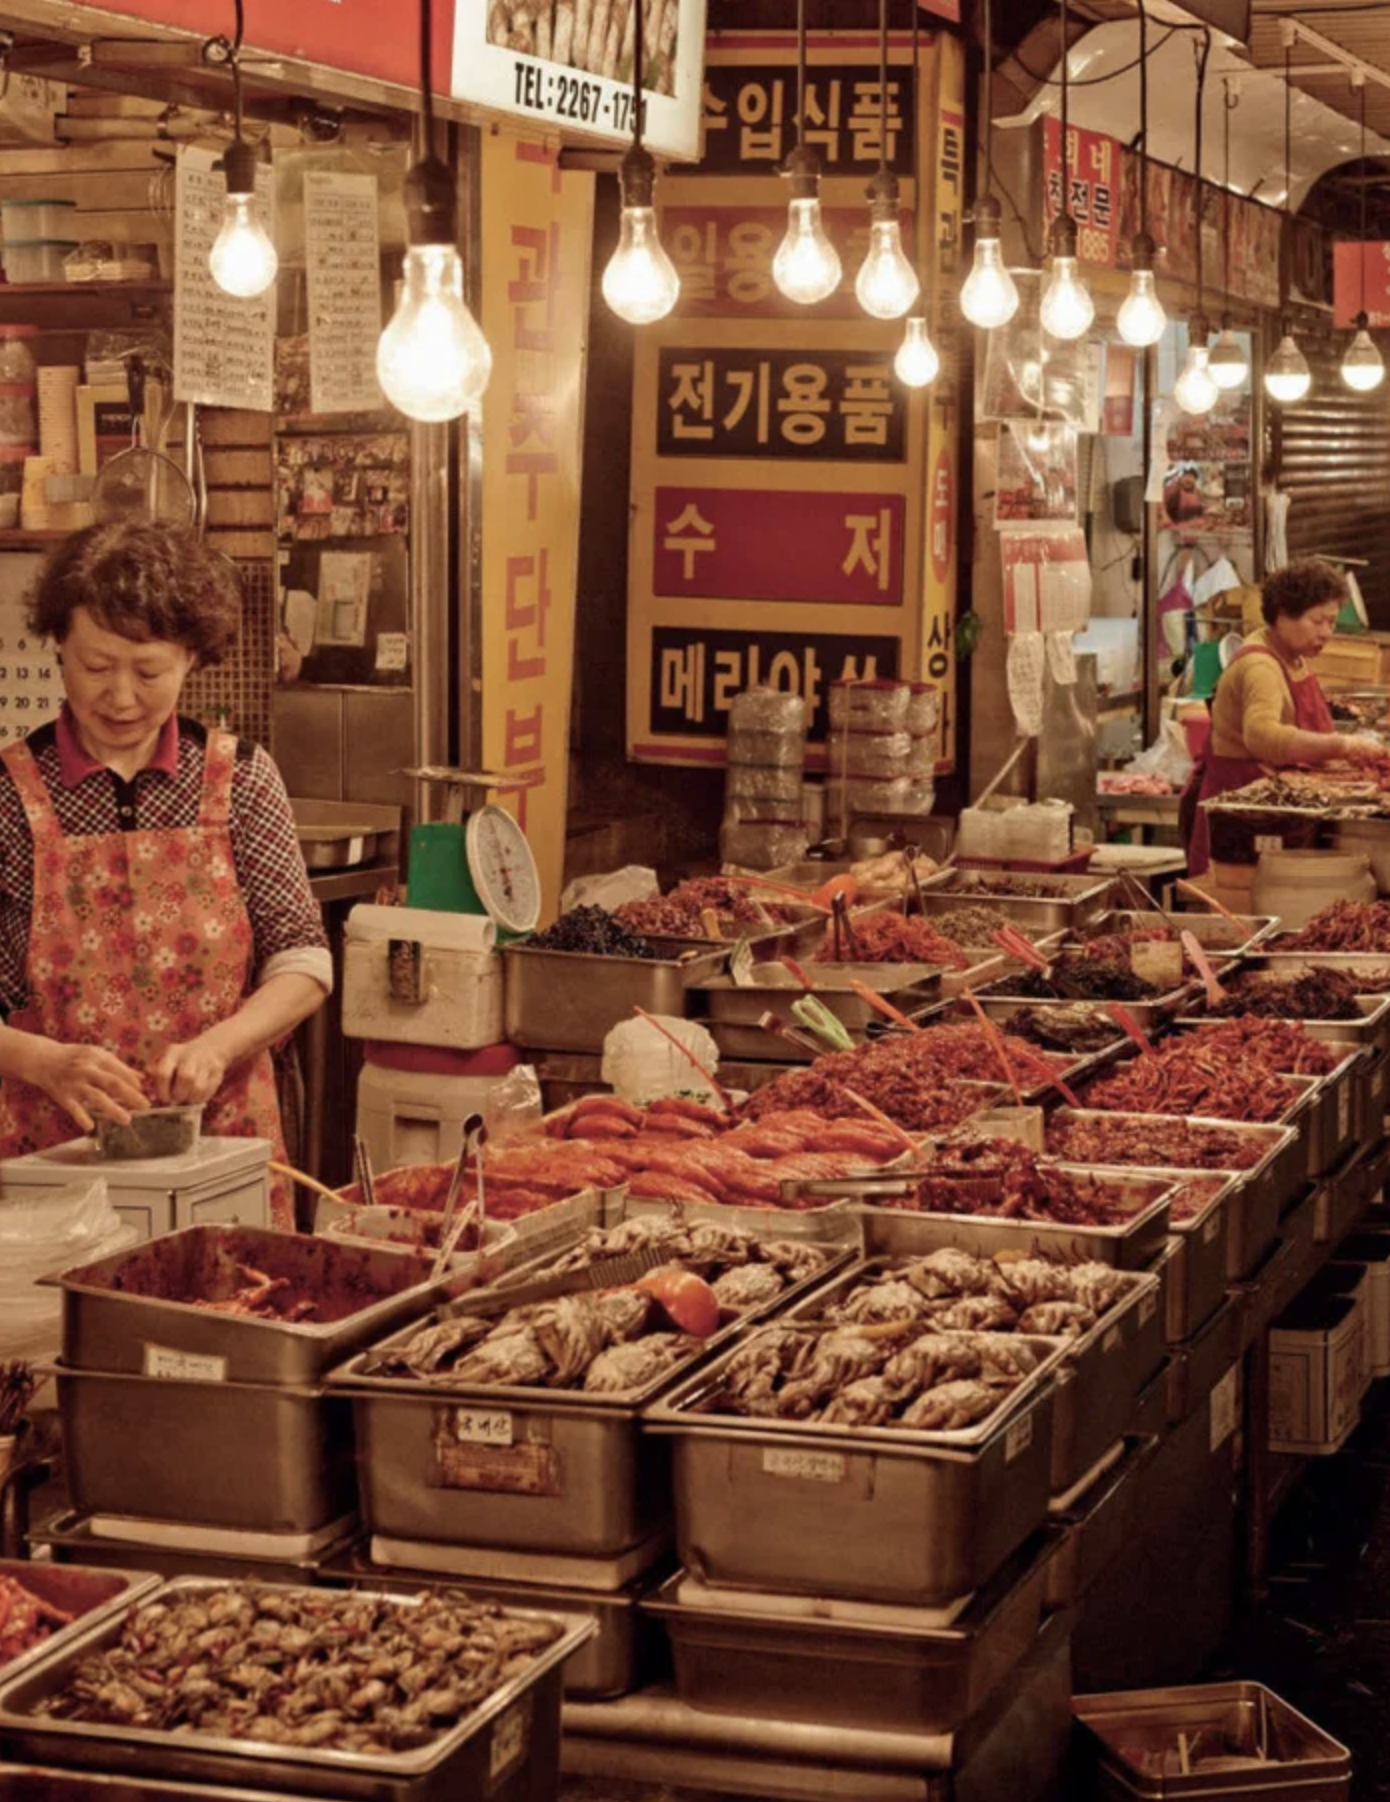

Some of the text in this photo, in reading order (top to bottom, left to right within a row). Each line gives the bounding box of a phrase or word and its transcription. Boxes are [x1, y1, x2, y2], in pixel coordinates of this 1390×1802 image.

[668, 361, 894, 445] 전기용품
[16, 667, 28, 679] 13
[38, 667, 51, 679] 14
[15, 696, 30, 709] 20
[37, 697, 49, 709] 21
